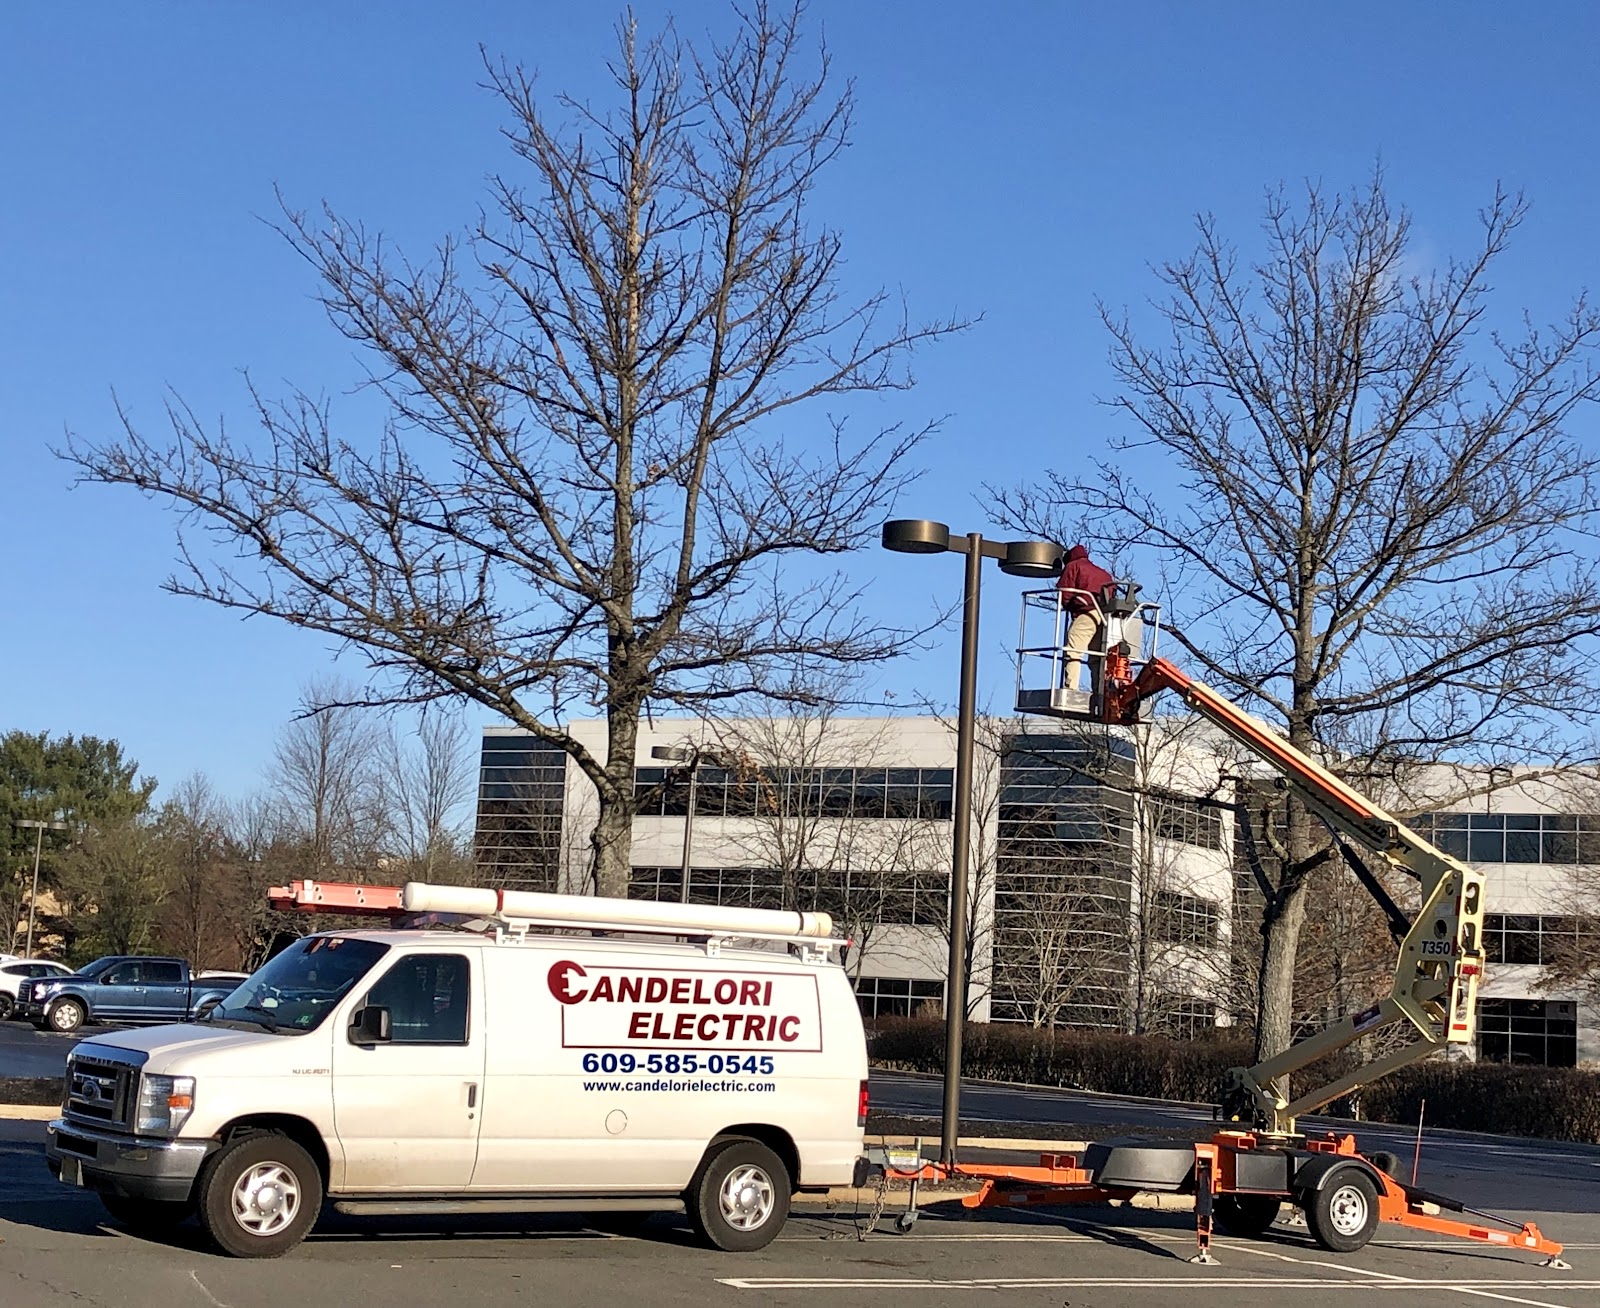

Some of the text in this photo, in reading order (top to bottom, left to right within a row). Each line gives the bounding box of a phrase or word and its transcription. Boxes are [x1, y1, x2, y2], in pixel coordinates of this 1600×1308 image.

[1421, 941, 1450, 955] T350
[547, 960, 773, 1006] CANDELORI
[627, 1012, 801, 1042] ELECTRIC
[582, 1053, 775, 1075] 609-585-0545
[583, 1079, 776, 1092] www.candelorielectric.com
